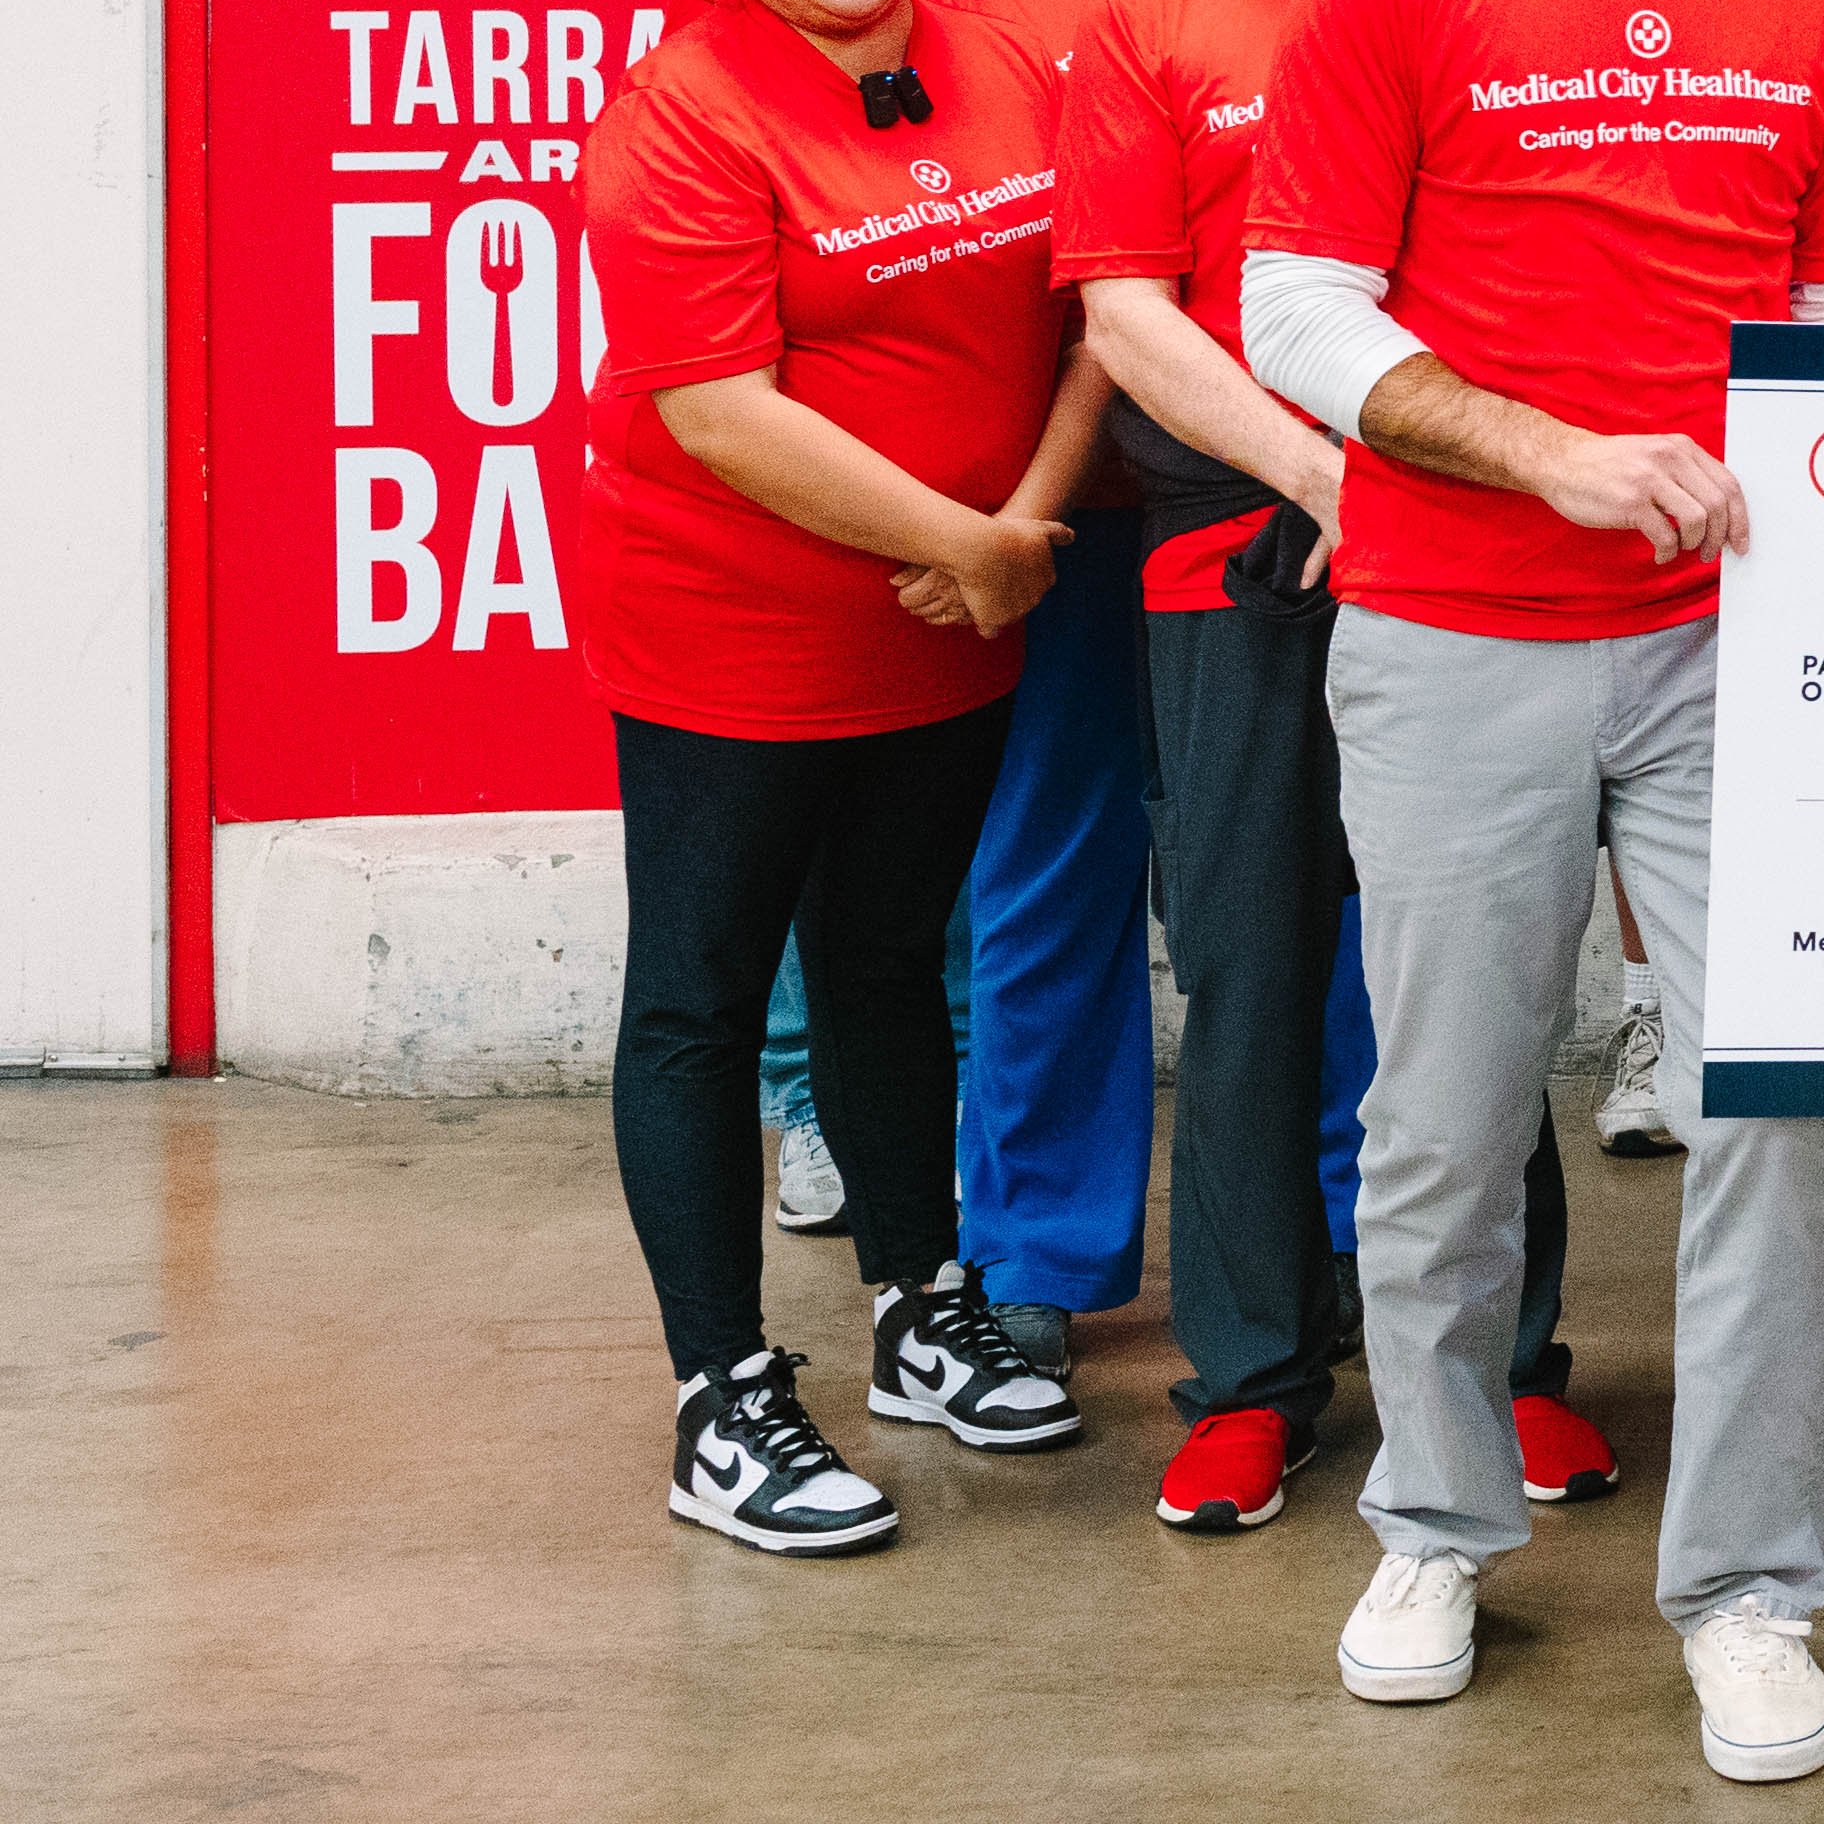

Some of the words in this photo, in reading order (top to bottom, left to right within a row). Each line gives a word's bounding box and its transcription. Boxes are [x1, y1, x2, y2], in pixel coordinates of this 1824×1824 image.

[331, 9, 665, 125] TARR
[1470, 70, 1597, 113] Medical
[1599, 69, 1658, 106] City
[1665, 67, 1810, 106] Healthcare
[459, 141, 580, 183] AR
[1519, 125, 1594, 151] Caring
[1597, 122, 1629, 146] for
[1630, 122, 1662, 145] the
[1664, 120, 1780, 151] Community
[813, 203, 923, 256] Medical
[918, 199, 962, 226] City
[956, 168, 1056, 216] Healthcar
[866, 253, 929, 284] Caring
[930, 245, 952, 265] for
[954, 238, 980, 258] the
[333, 199, 606, 428] FO
[335, 444, 570, 655] BA
